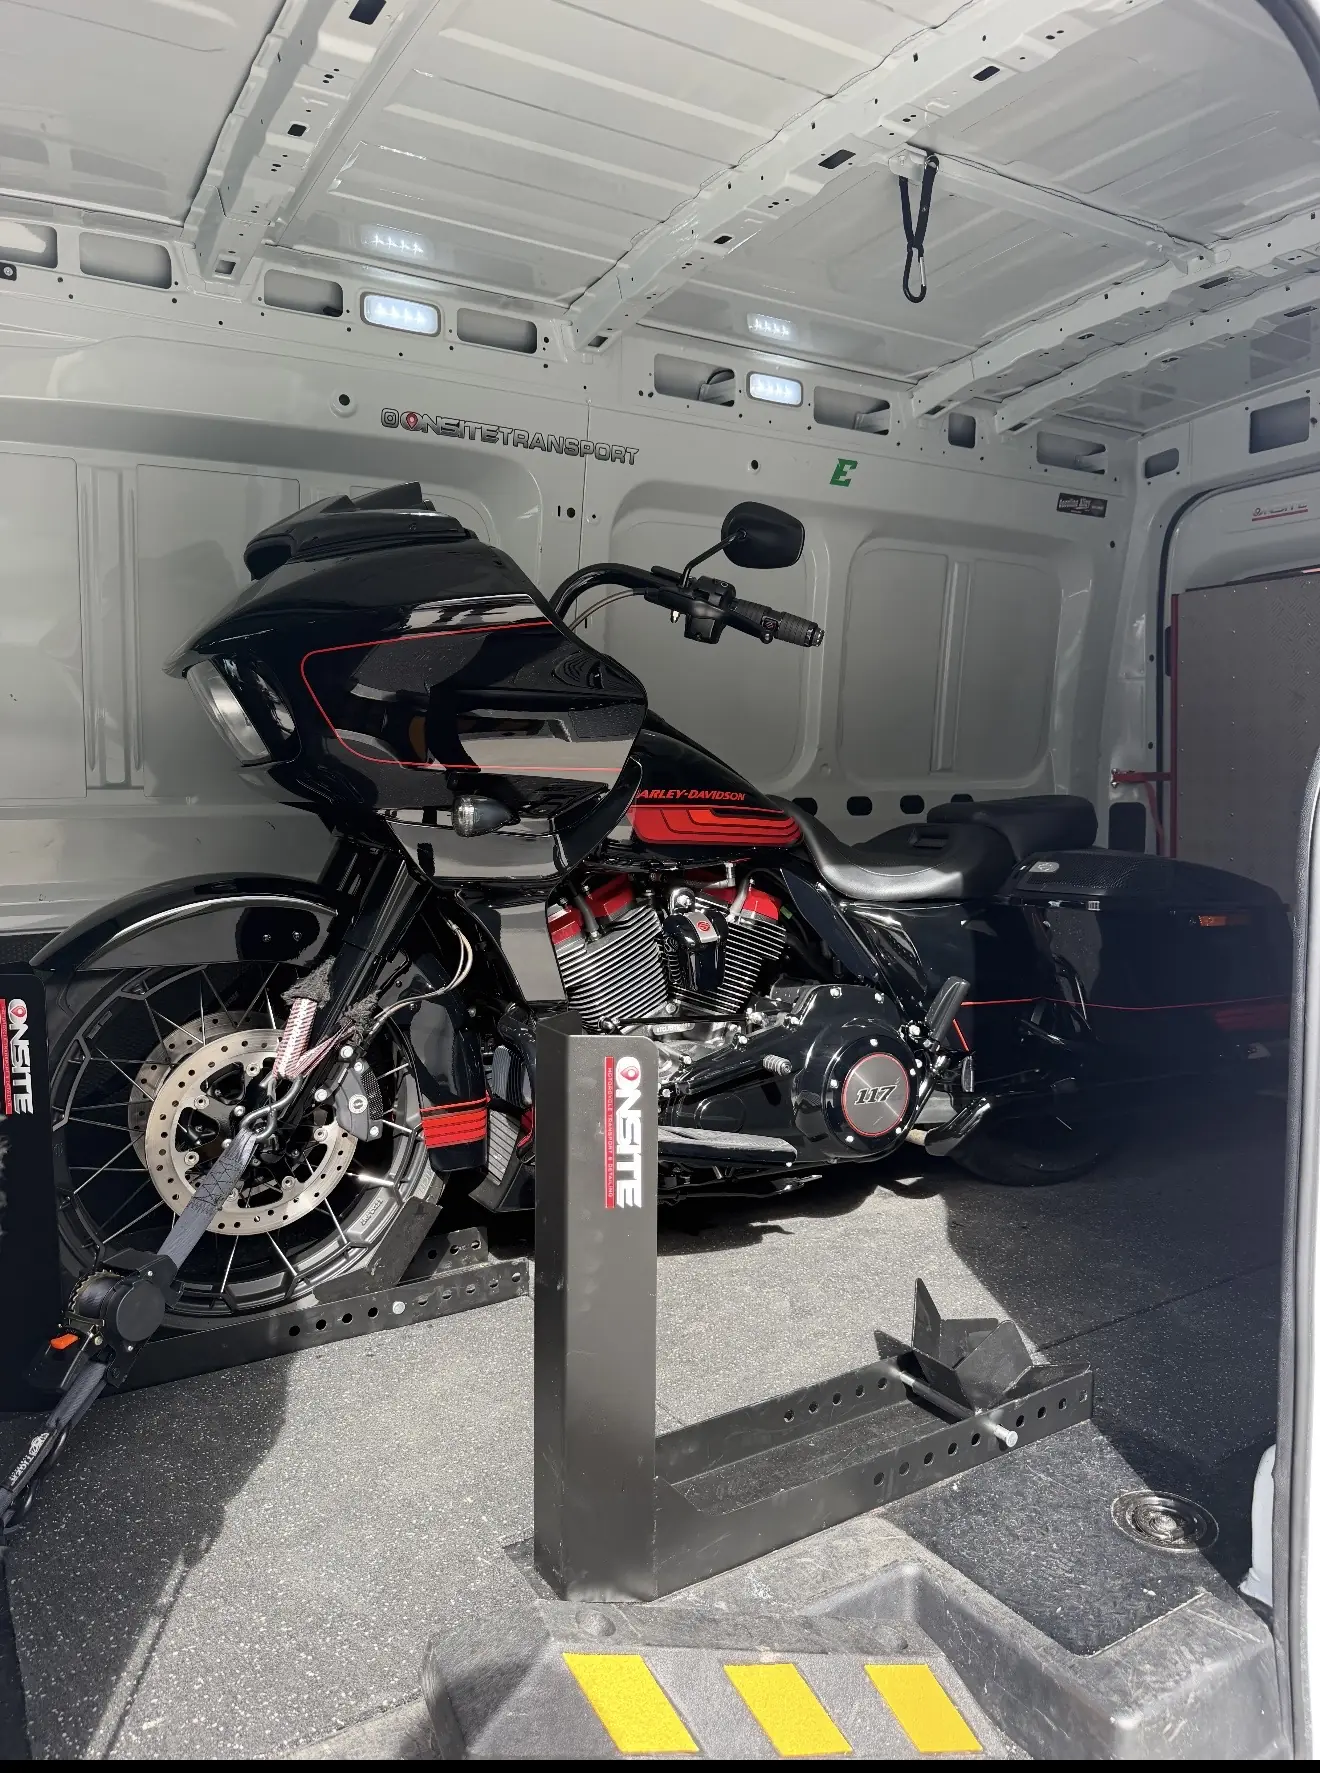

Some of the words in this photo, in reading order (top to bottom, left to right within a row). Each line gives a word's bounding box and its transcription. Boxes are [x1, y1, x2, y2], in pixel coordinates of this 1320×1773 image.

[400, 411, 640, 466] ONSITETRANSPORT
[829, 458, 858, 487] E
[636, 789, 747, 801] ARLEY-DAVIDSON
[8, 998, 33, 1114] ONSITE
[853, 1084, 898, 1106] 117
[615, 1056, 642, 1209] ONSITE
